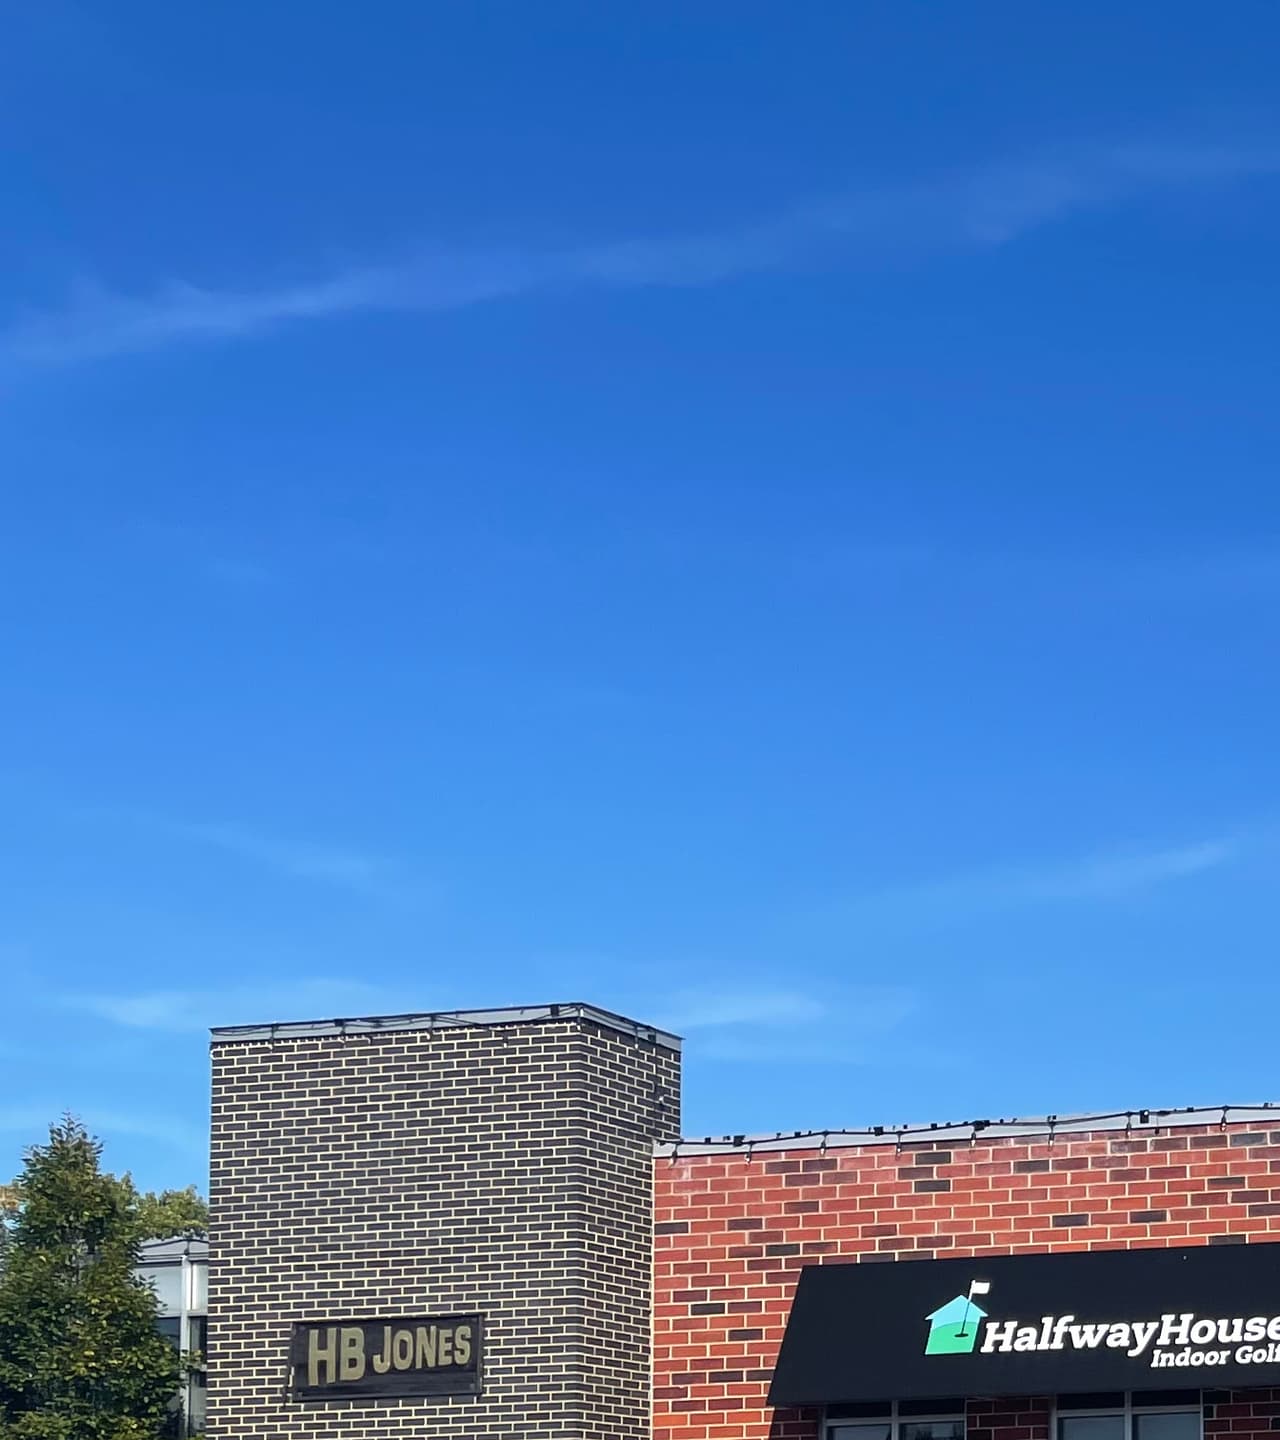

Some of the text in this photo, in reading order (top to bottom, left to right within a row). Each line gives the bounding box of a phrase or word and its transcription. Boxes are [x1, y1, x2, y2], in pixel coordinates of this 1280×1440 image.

[307, 1325, 472, 1386] HB JONES
[1150, 1347, 1230, 1368] Indoor
